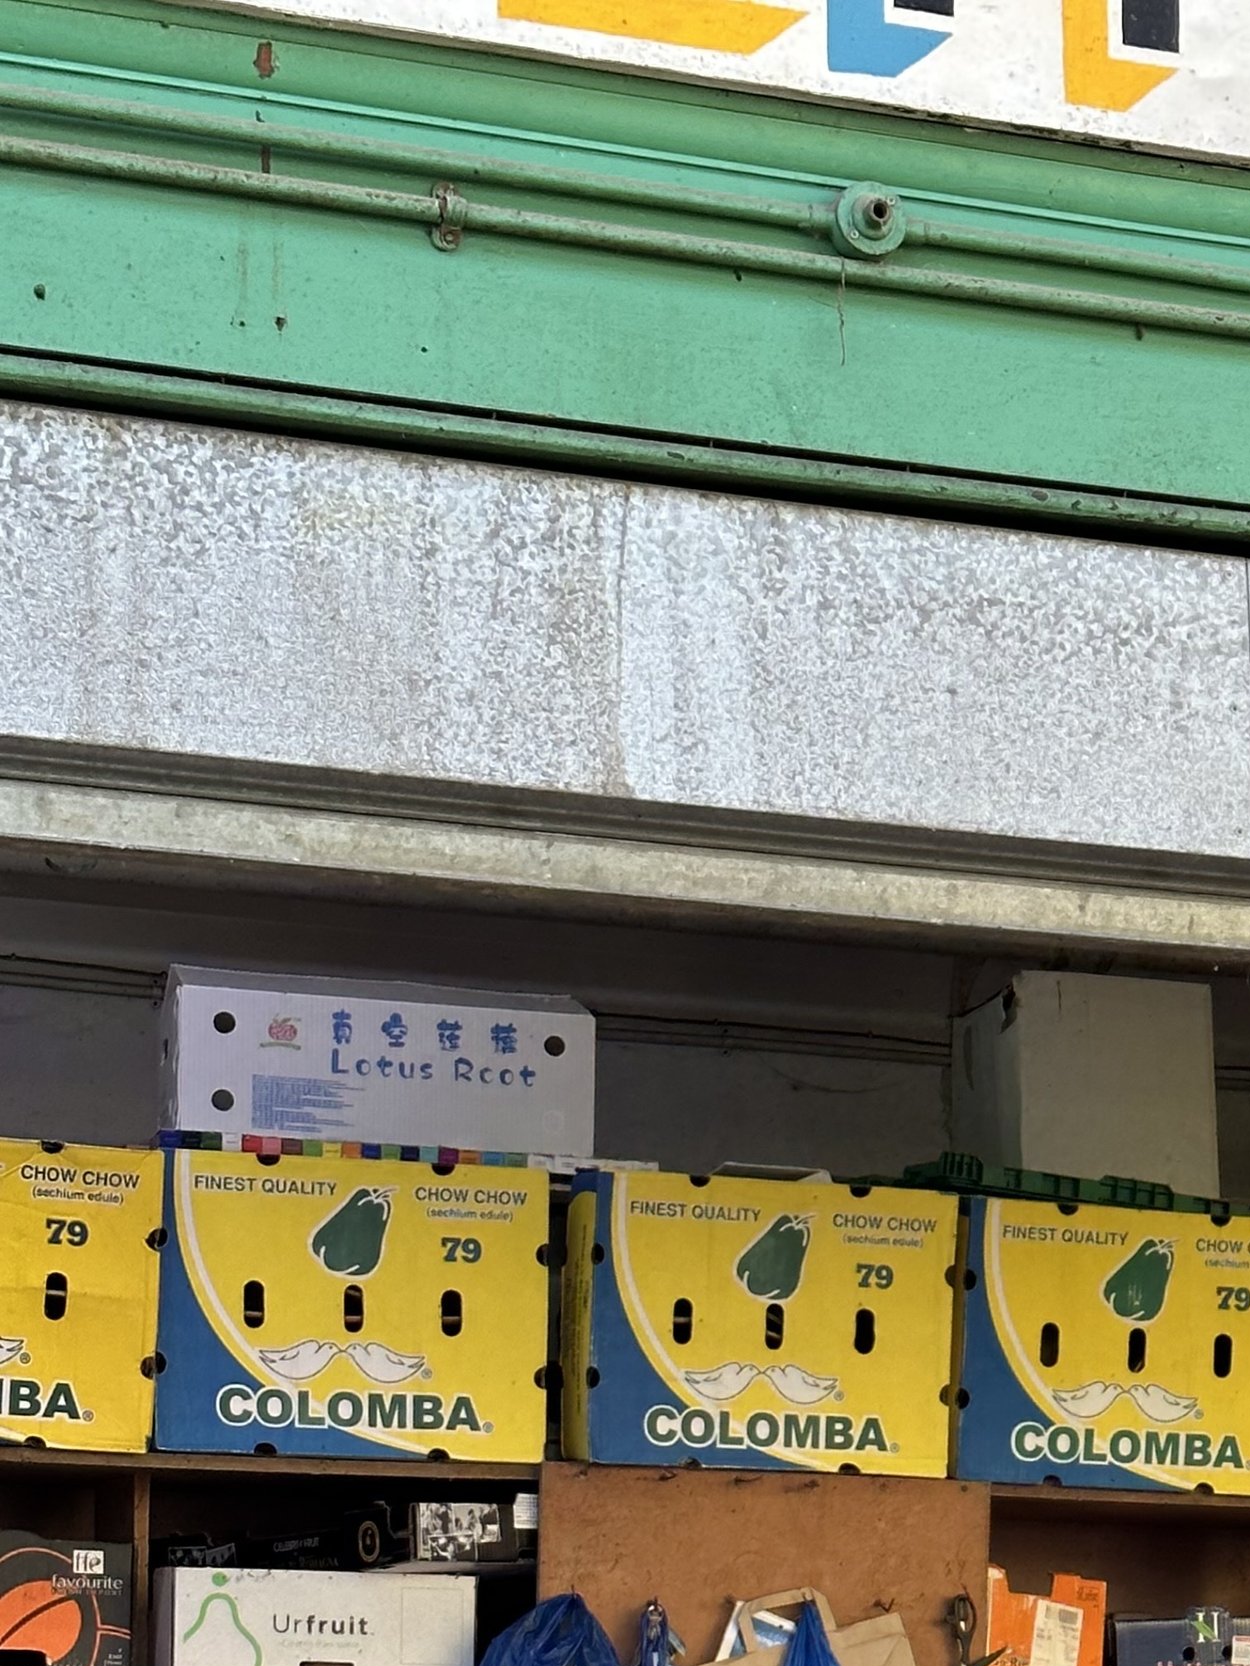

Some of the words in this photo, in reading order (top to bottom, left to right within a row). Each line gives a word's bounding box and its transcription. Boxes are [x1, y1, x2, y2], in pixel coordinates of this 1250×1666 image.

[331, 1049, 434, 1081] Lotus
[21, 1165, 78, 1184] CHOW
[83, 1170, 140, 1190] CHOW
[194, 1175, 256, 1194] FINEST
[261, 1177, 338, 1198] QUALITY
[415, 1186, 469, 1204] CHOW
[473, 1188, 528, 1206] CHOW
[630, 1200, 687, 1218] FINEST
[690, 1204, 762, 1223] QUALITY
[832, 1213, 883, 1230] CHOW
[886, 1216, 938, 1233] CHOW
[45, 1218, 90, 1247] 79
[1002, 1224, 1058, 1241] FINEST
[1061, 1228, 1129, 1247] QUALITY
[1195, 1238, 1246, 1254] CHOW
[441, 1237, 482, 1263] 79
[856, 1263, 894, 1289] 79
[216, 1384, 482, 1433] COLOMBA
[645, 1405, 889, 1453] COLOMBA
[1012, 1422, 1246, 1470] COLOMBA
[51, 1573, 124, 1590] favourite
